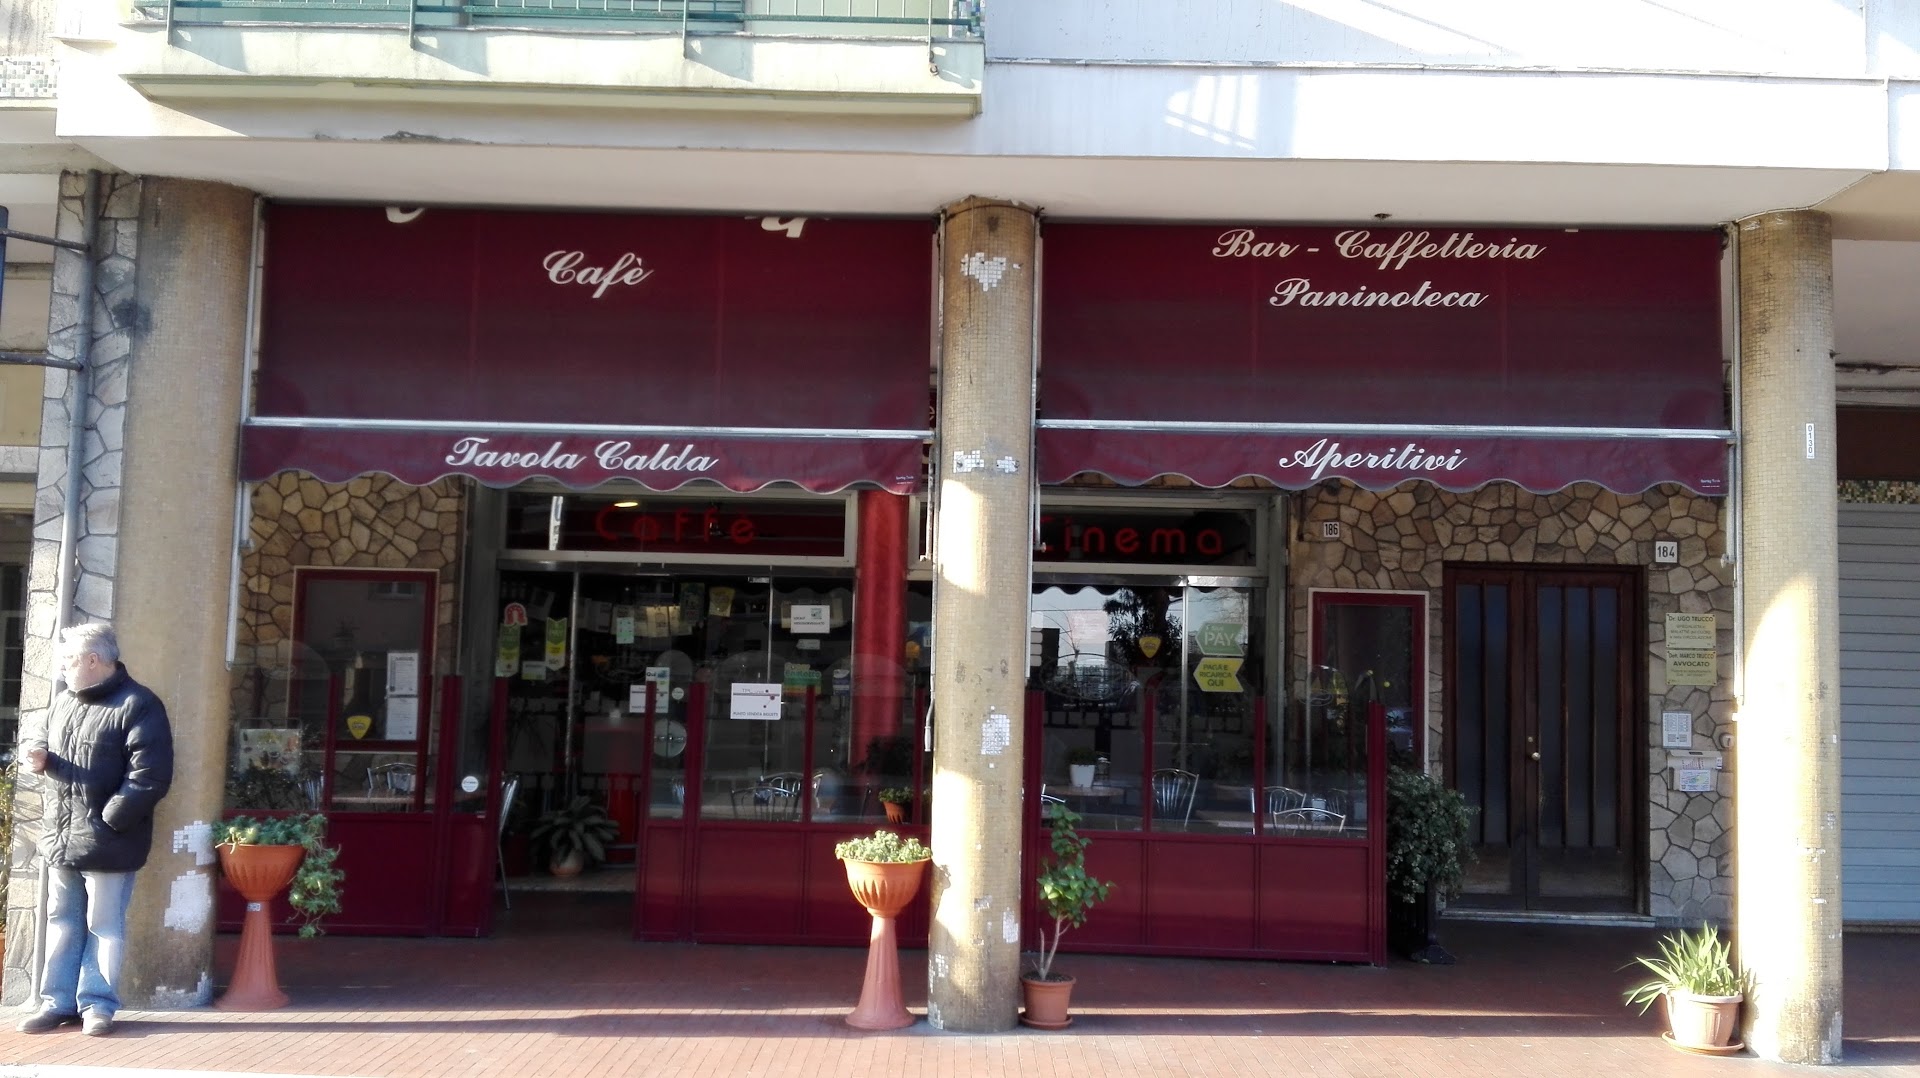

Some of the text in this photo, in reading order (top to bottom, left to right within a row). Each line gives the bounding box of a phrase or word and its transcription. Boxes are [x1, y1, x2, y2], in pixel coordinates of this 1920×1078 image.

[1212, 228, 1298, 259] Bar
[1335, 229, 1546, 270] Caffetteria
[542, 249, 655, 299] Cafè
[1269, 277, 1490, 309] Paninoteca
[445, 436, 720, 473] Tavola Calda
[1278, 438, 1468, 479] Aperitivi
[1324, 523, 1339, 537] 186
[1657, 546, 1675, 558] 184
[1204, 632, 1234, 646] PAY
[1207, 678, 1224, 687] QUI
